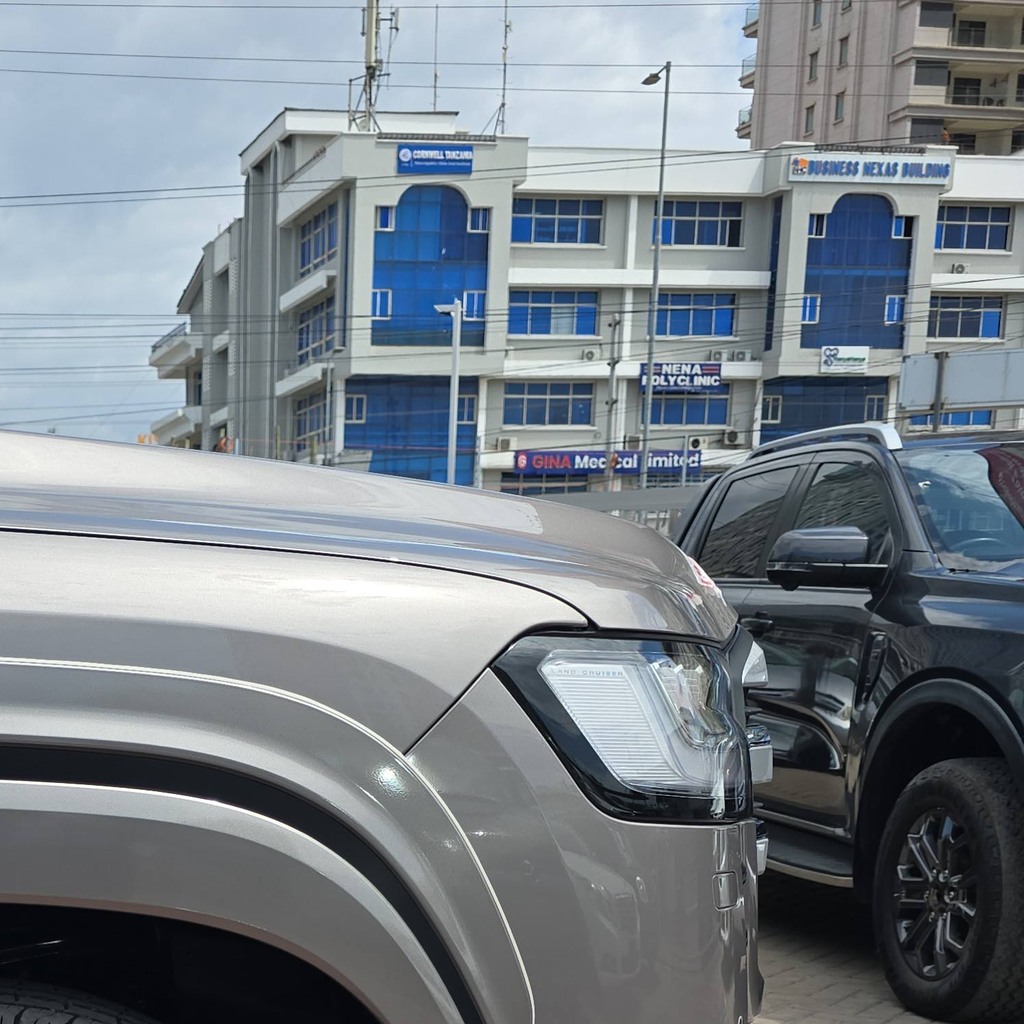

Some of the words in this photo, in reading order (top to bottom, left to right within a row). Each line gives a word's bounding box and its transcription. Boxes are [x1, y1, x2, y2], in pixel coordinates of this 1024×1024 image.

[807, 160, 859, 175] BUSINESS
[901, 162, 951, 178] BUILDING
[661, 363, 702, 375] NENA
[532, 454, 571, 469] GINA
